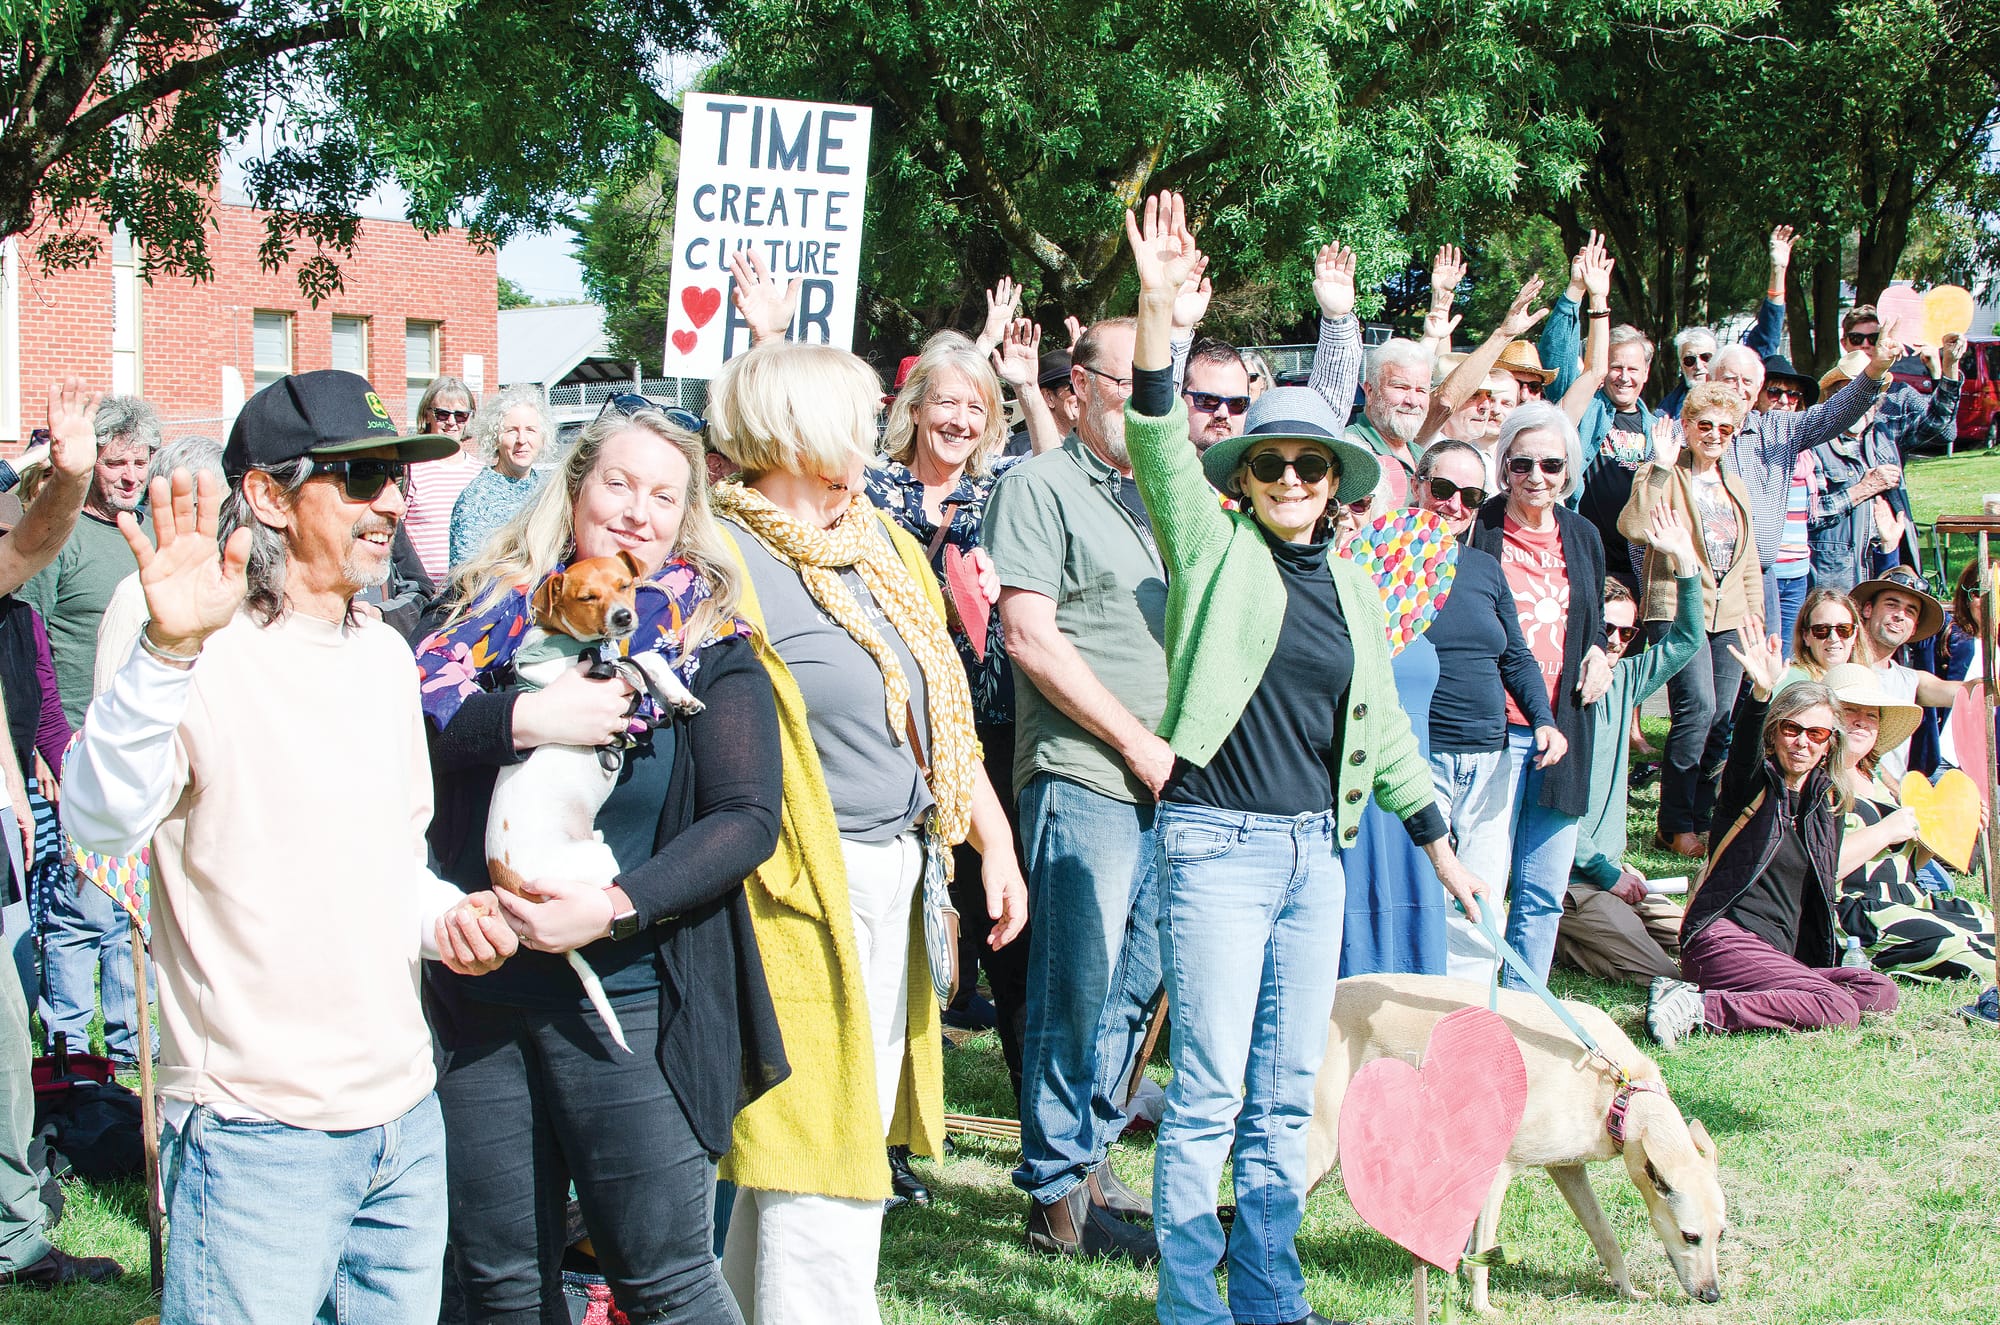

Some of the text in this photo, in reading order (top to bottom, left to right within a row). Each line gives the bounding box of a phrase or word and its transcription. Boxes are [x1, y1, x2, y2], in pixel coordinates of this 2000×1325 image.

[706, 102, 857, 175] TIME
[693, 183, 850, 231] CREATE
[1503, 545, 1536, 568] SUN
